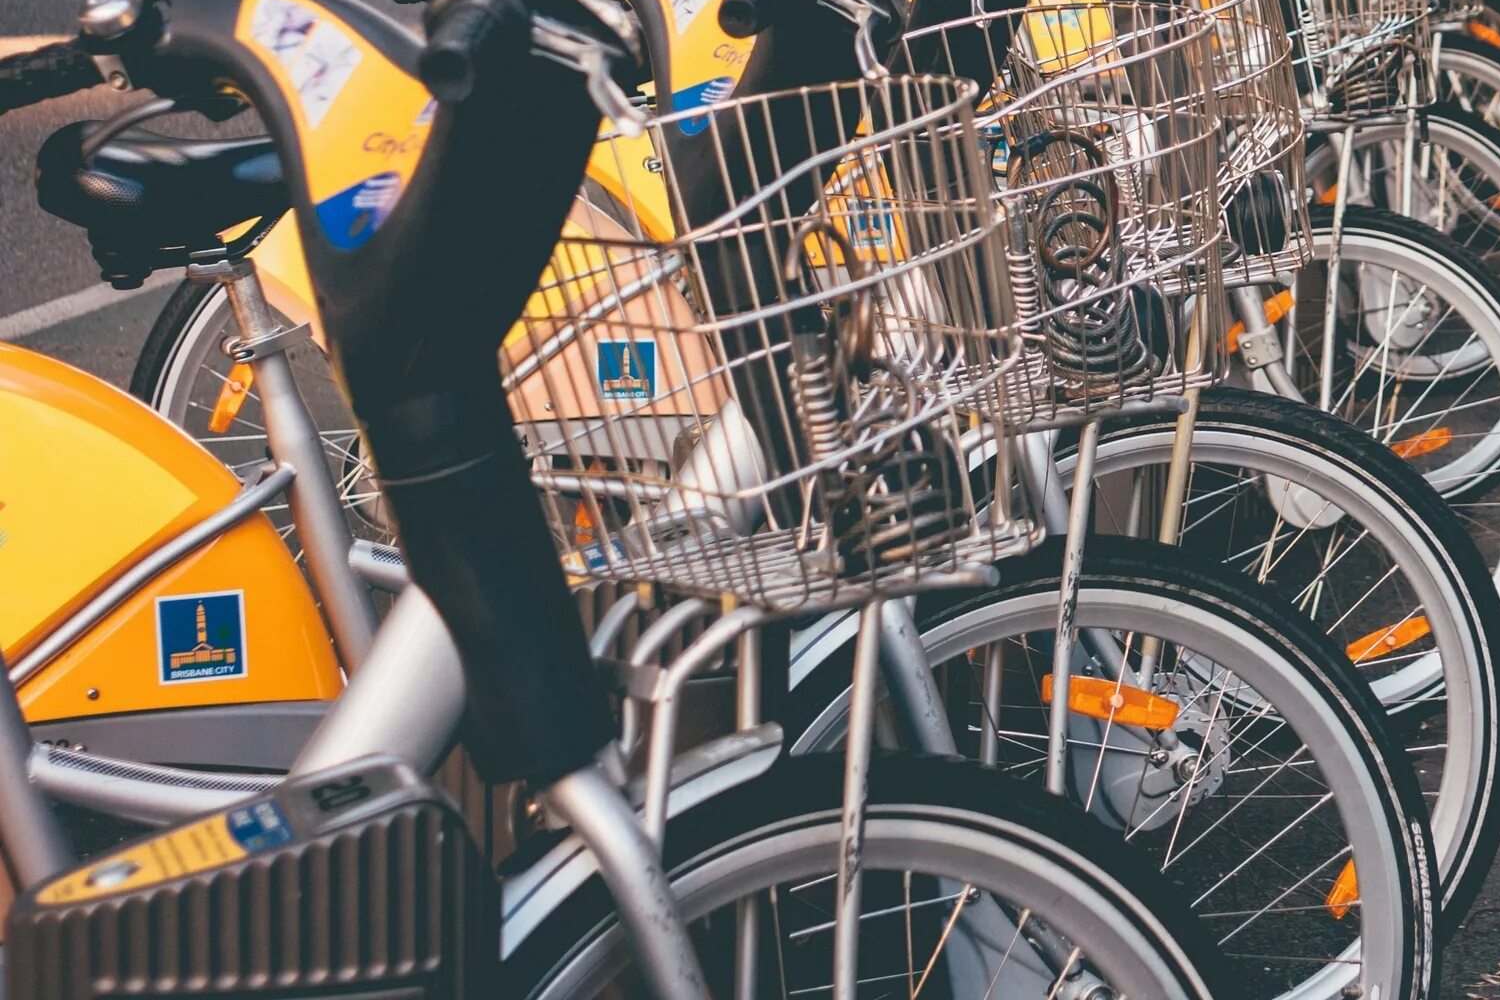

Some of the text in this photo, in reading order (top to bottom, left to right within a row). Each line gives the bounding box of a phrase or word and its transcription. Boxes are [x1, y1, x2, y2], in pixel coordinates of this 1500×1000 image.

[170, 665, 236, 680] BRISBANE CITY
[1410, 821, 1433, 927] SCHWALBE
